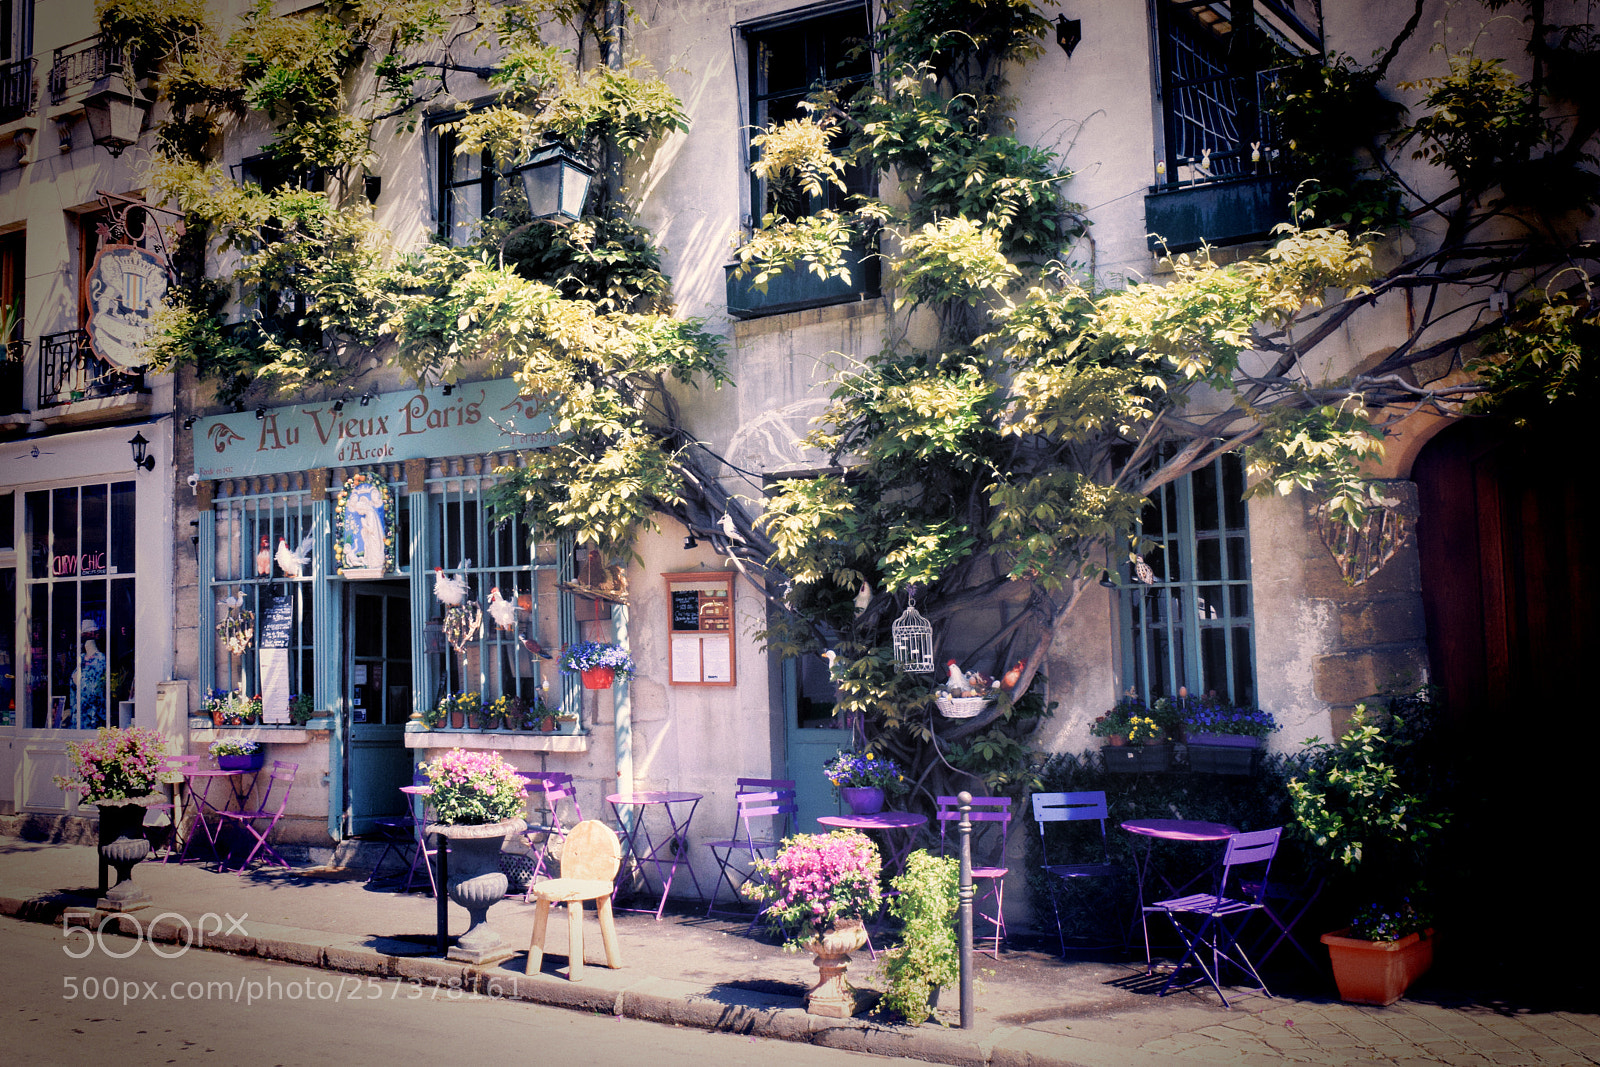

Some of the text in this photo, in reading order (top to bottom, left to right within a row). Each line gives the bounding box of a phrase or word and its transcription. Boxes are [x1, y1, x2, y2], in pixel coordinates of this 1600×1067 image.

[256, 389, 486, 452] Au Vieux Paris
[338, 441, 395, 461] d'Arcole
